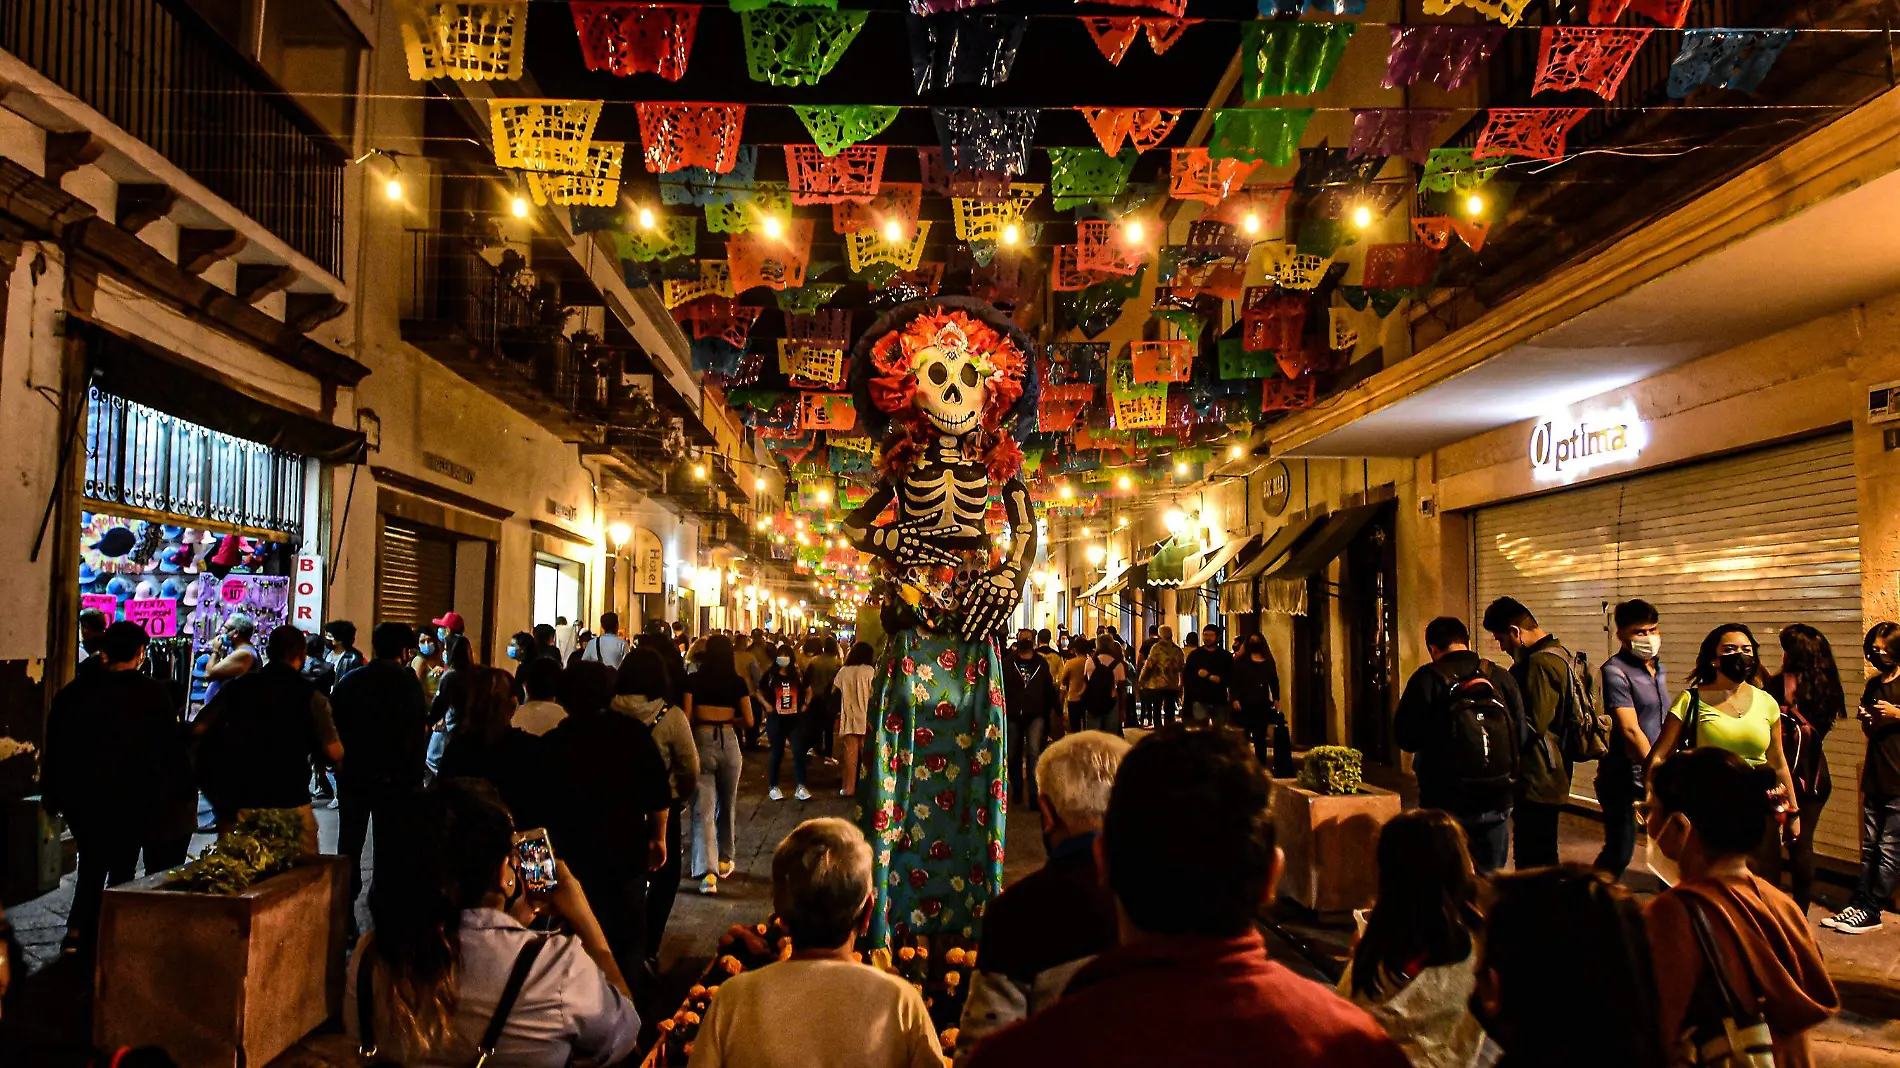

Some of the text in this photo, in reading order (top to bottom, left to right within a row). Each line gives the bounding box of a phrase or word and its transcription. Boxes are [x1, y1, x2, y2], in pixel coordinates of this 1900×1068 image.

[1529, 421, 1628, 472] Optima
[648, 548, 660, 586] Hotel
[297, 558, 314, 635] BOR
[136, 617, 165, 635] 70
